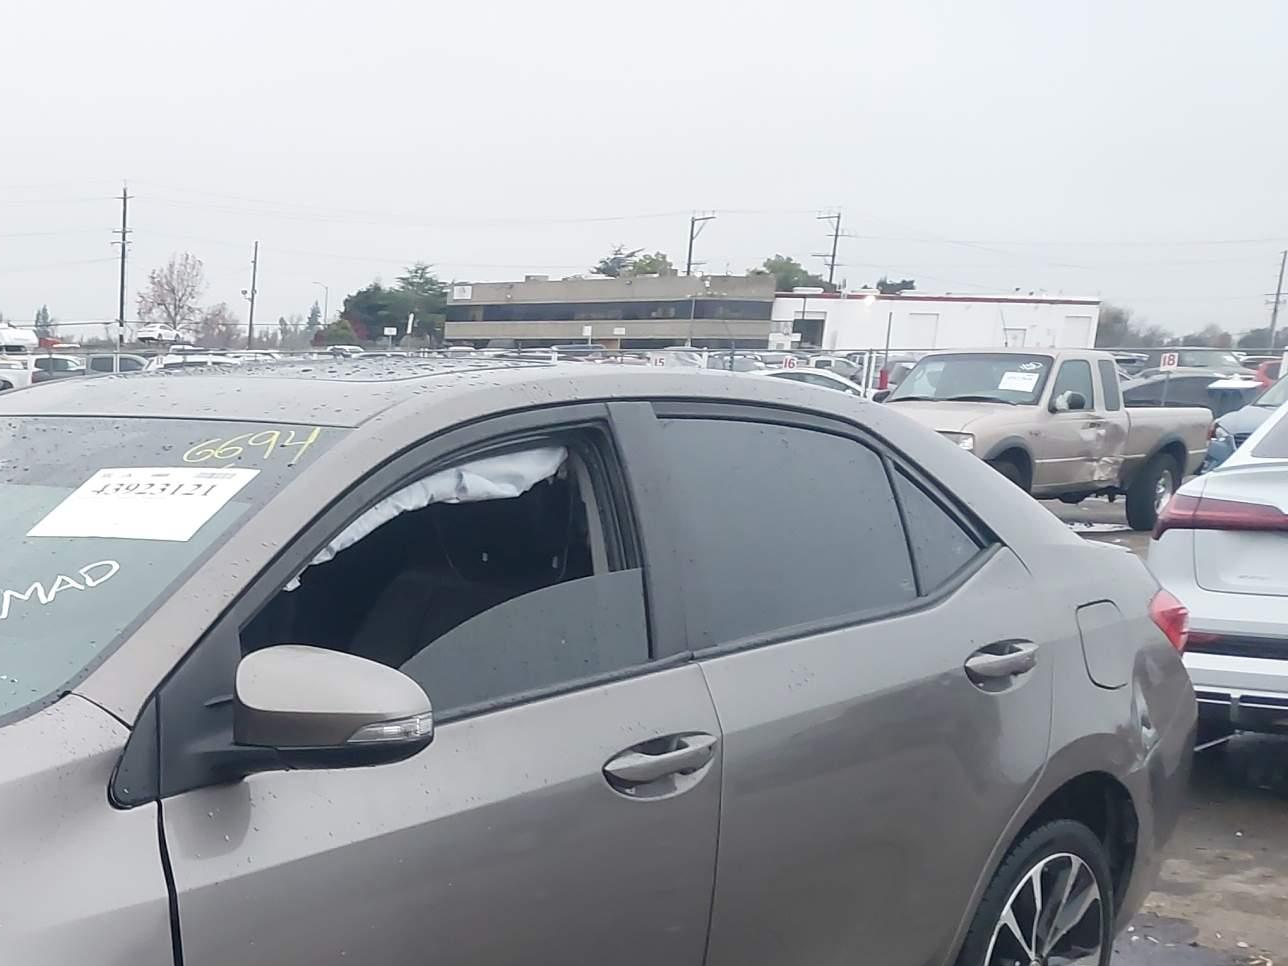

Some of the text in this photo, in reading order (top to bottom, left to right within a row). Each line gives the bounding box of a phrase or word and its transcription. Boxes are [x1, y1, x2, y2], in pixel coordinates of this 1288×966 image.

[783, 358, 796, 369] 16
[1162, 354, 1176, 366] 18
[183, 426, 320, 464] 6694
[0, 560, 120, 619] MAD
